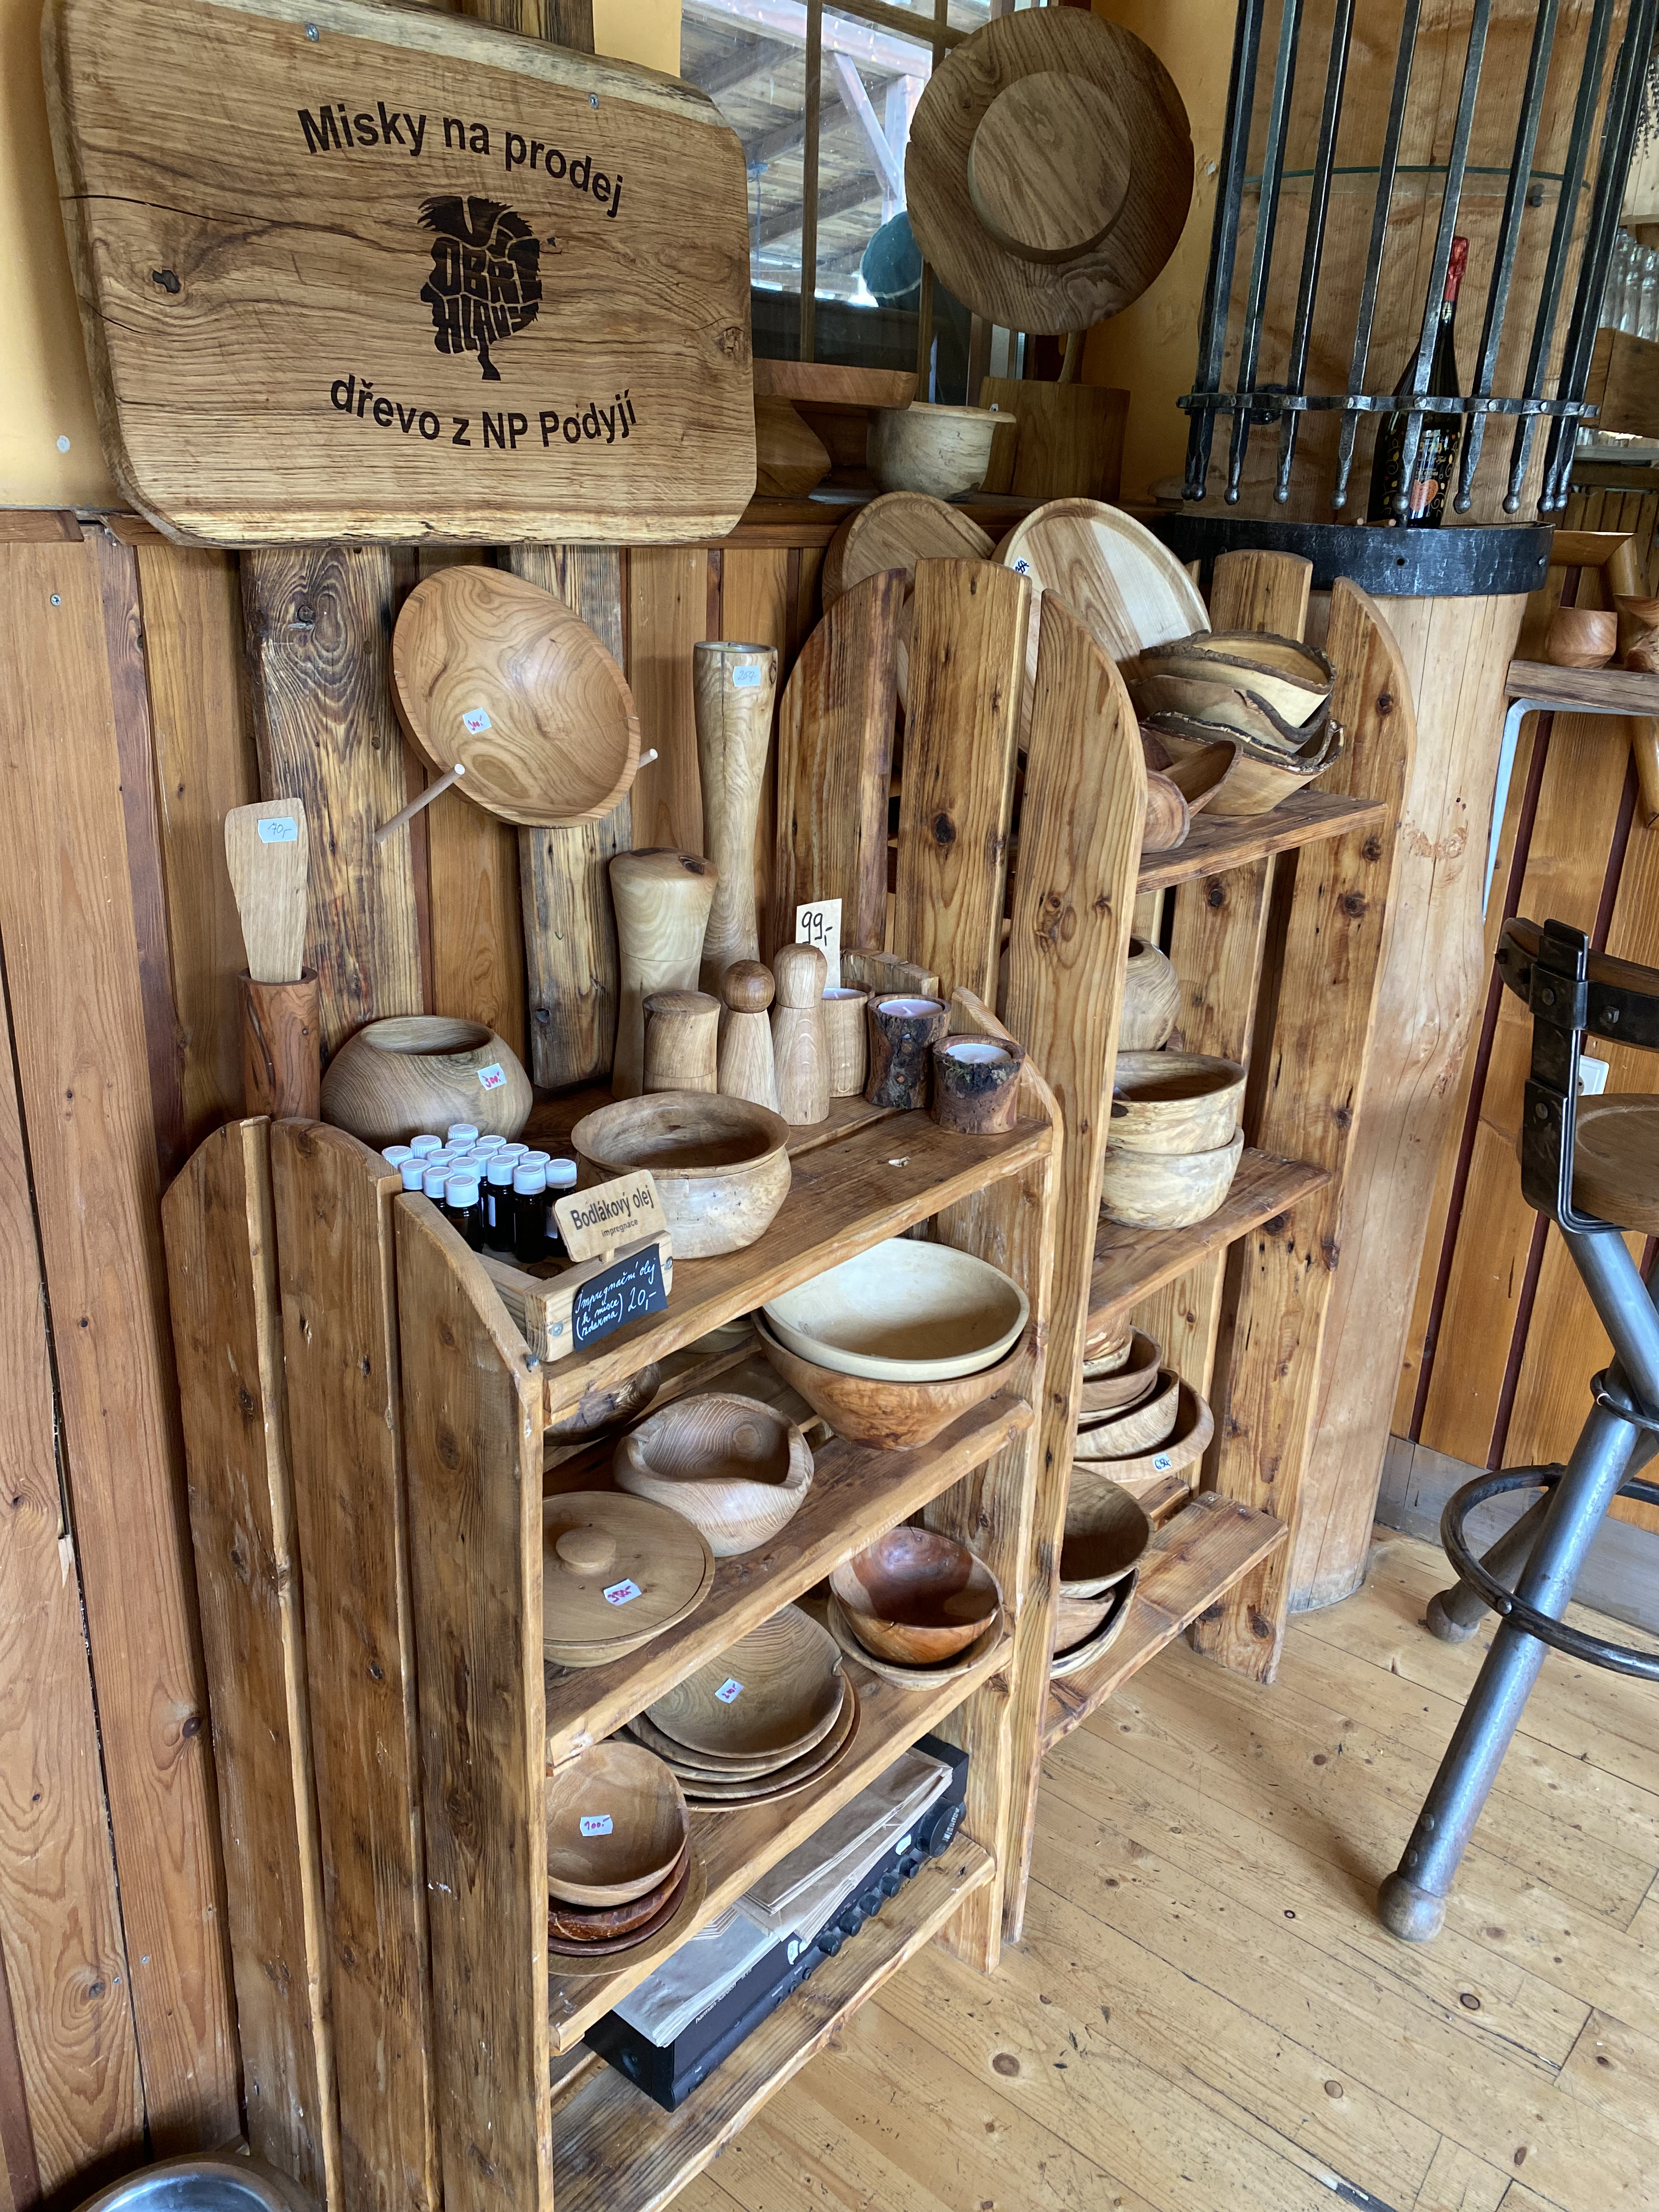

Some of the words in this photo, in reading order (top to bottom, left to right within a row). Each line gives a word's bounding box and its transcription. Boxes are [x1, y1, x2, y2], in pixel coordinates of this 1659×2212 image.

[297, 101, 426, 157] Misky
[443, 116, 490, 156] na
[505, 132, 623, 217] prodej
[330, 374, 440, 440] dřevo
[452, 416, 471, 447] z
[482, 411, 528, 449] NP
[539, 388, 637, 447] Podyjí
[801, 911, 833, 947] 99,-
[569, 1192, 631, 1231] Bodlákový
[633, 1184, 654, 1209] olej
[601, 1218, 639, 1238] impregnace
[639, 1257, 657, 1285] olej
